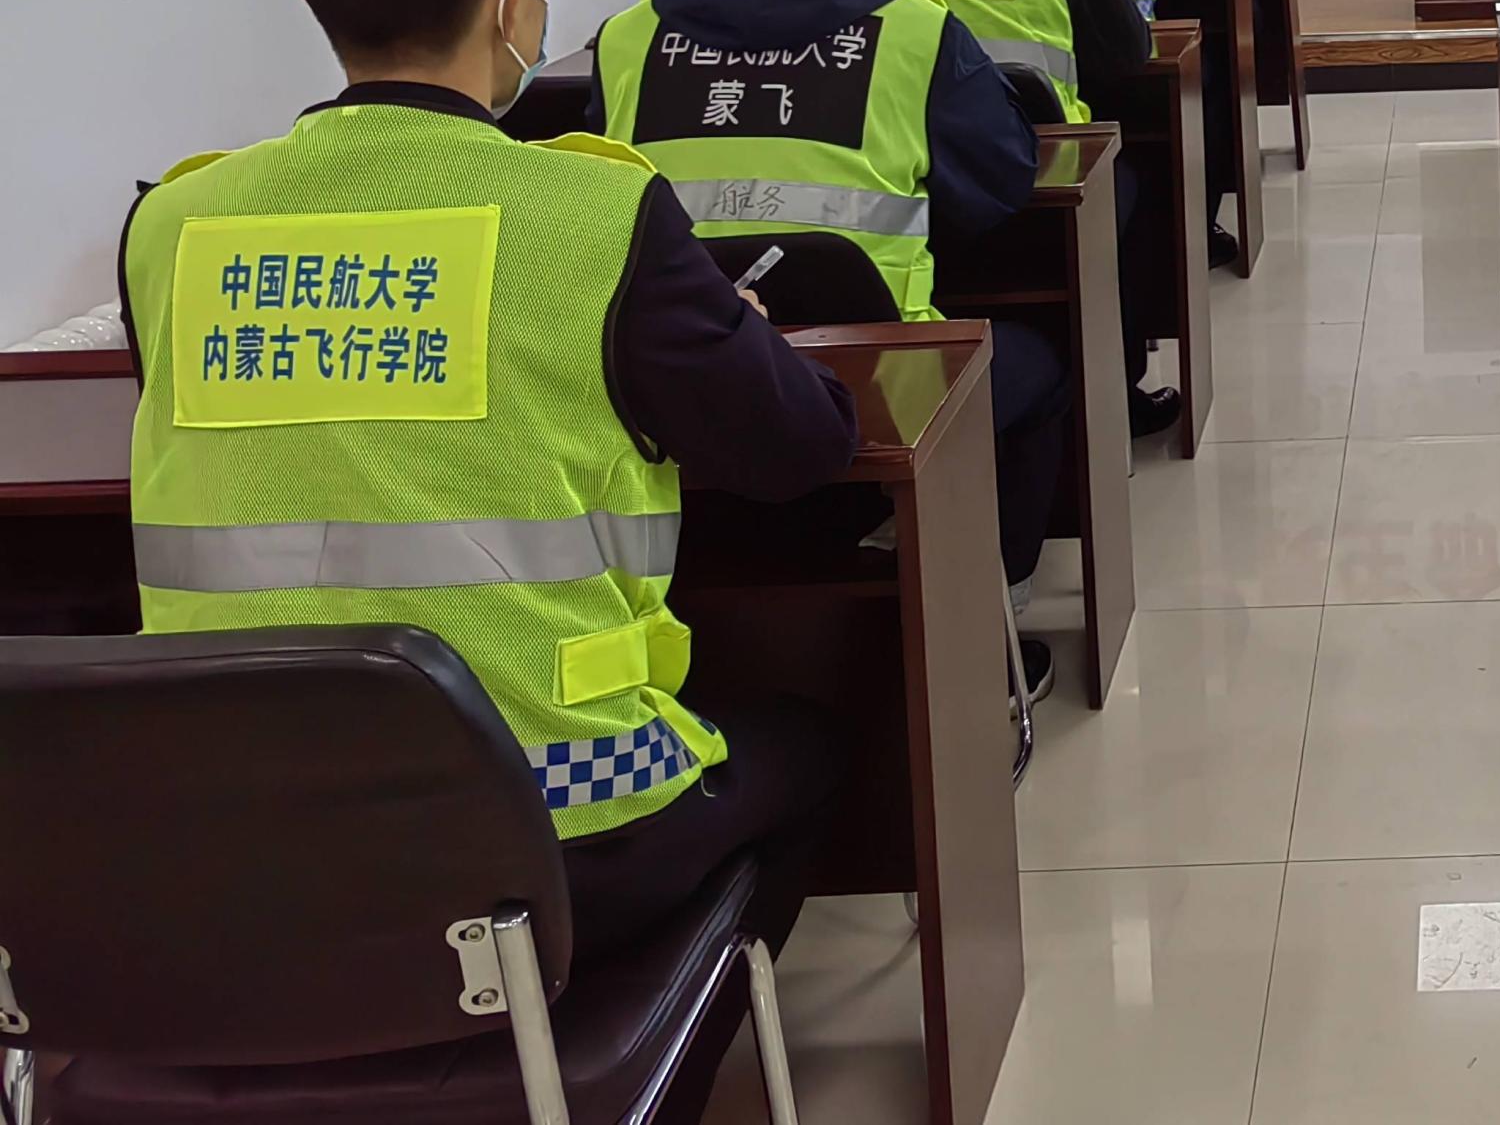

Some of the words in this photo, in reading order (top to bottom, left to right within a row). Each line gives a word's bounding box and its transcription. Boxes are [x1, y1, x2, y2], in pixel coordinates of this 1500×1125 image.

[702, 80, 795, 125] 蒙飞
[222, 254, 438, 312] 中国民航大学
[203, 324, 448, 383] 内蒙古飞行学院
